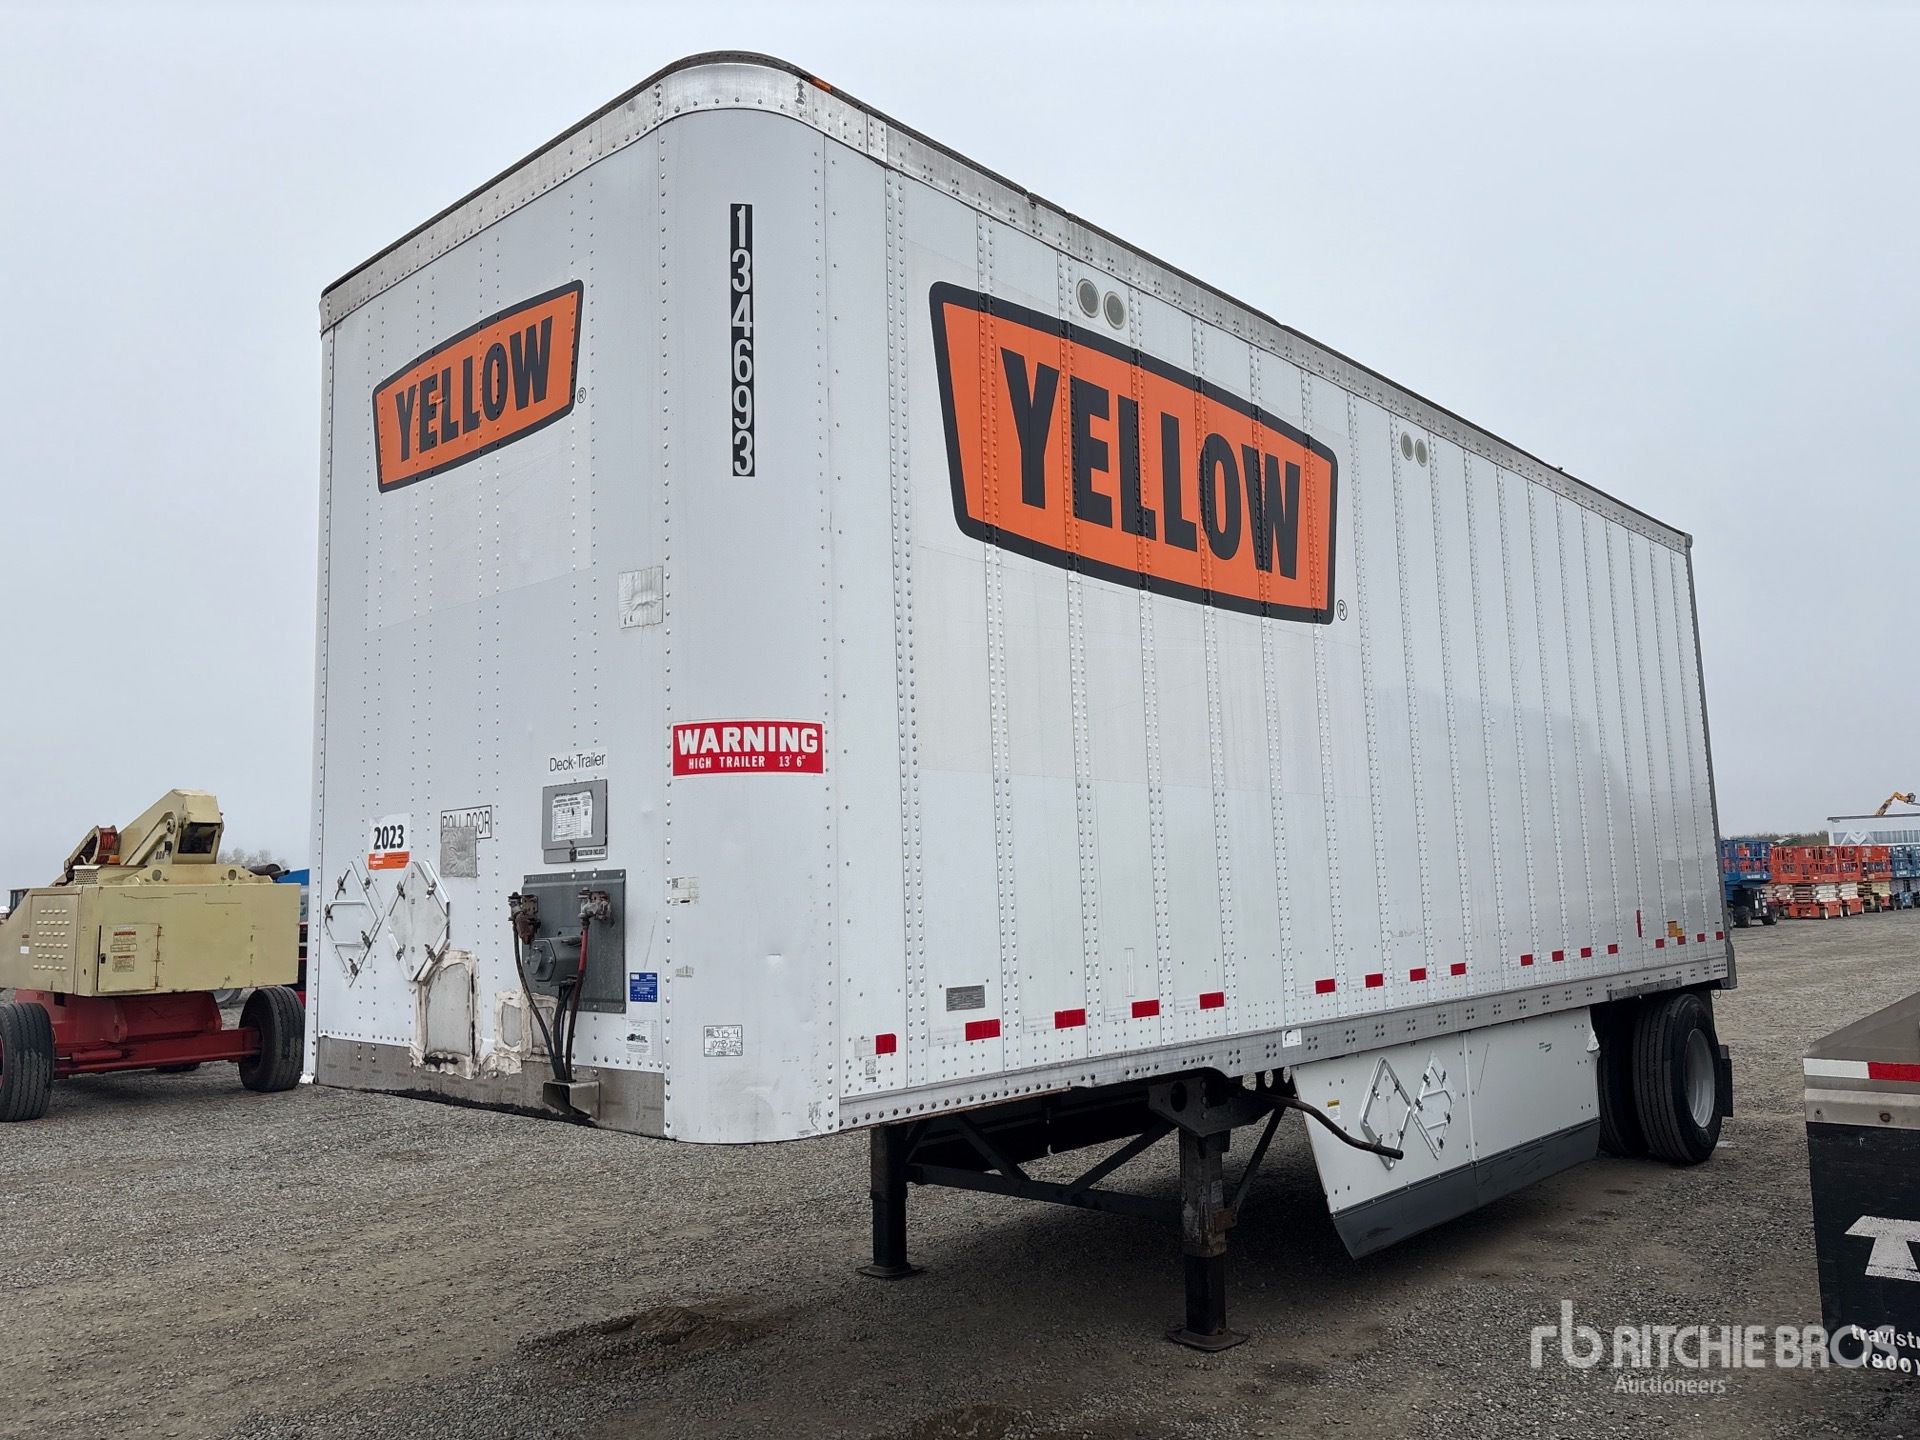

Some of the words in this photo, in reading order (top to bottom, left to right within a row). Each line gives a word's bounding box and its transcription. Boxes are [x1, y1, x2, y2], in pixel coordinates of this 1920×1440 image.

[731, 205, 754, 476] 134693
[395, 315, 553, 463] YELLOW
[1000, 346, 1301, 580] YELLOW
[677, 726, 818, 755] WARNING
[688, 756, 712, 769] HIGH
[719, 755, 765, 768] TRAILER
[373, 824, 404, 850] 2023
